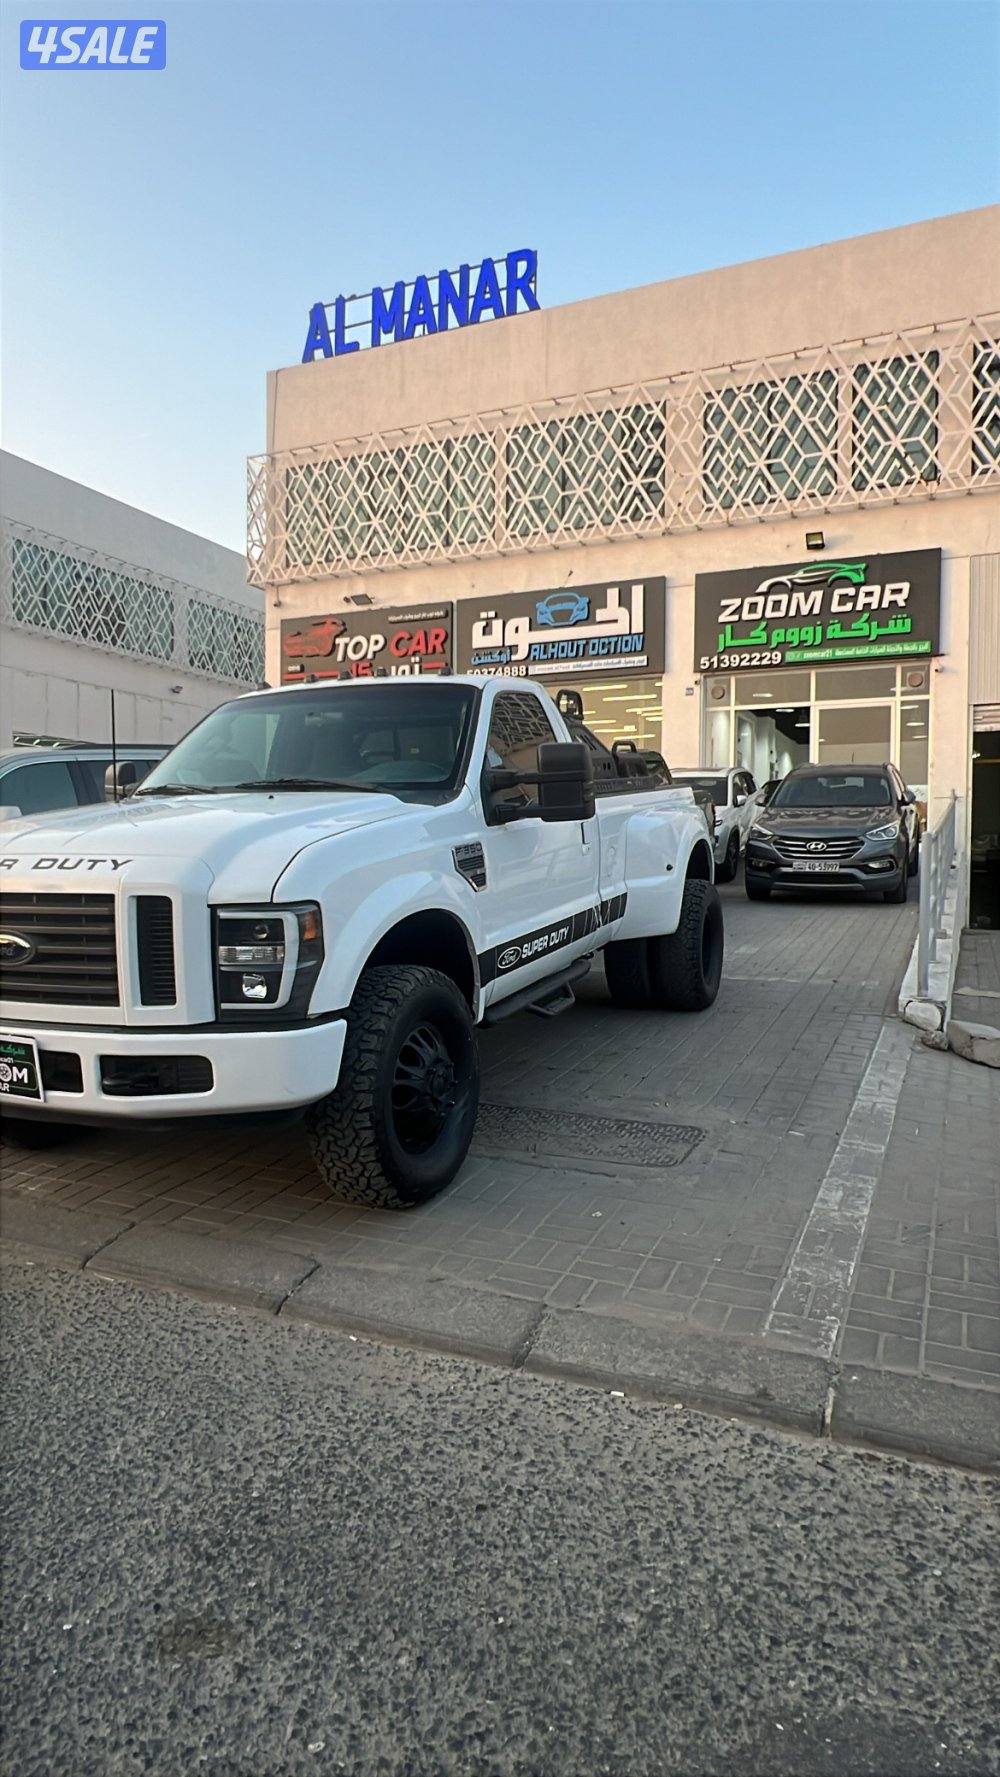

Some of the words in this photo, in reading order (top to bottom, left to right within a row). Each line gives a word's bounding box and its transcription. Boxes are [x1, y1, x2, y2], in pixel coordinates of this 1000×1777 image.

[301, 294, 360, 364] AL
[371, 248, 541, 348] MANAR
[718, 590, 824, 623] ZOOM
[831, 582, 910, 614] CAR
[471, 584, 644, 661] الحوت
[717, 620, 768, 653] كار
[770, 621, 823, 649] زووم
[827, 612, 912, 642] شركة
[335, 633, 386, 662] TOP
[390, 627, 447, 657] CAR
[530, 639, 587, 661] ALHOUT
[589, 634, 644, 656] OCTION
[699, 651, 782, 669] 51392229
[31, 858, 134, 871] DUTY
[521, 934, 549, 959] SUPER
[549, 925, 570, 947] DUTY
